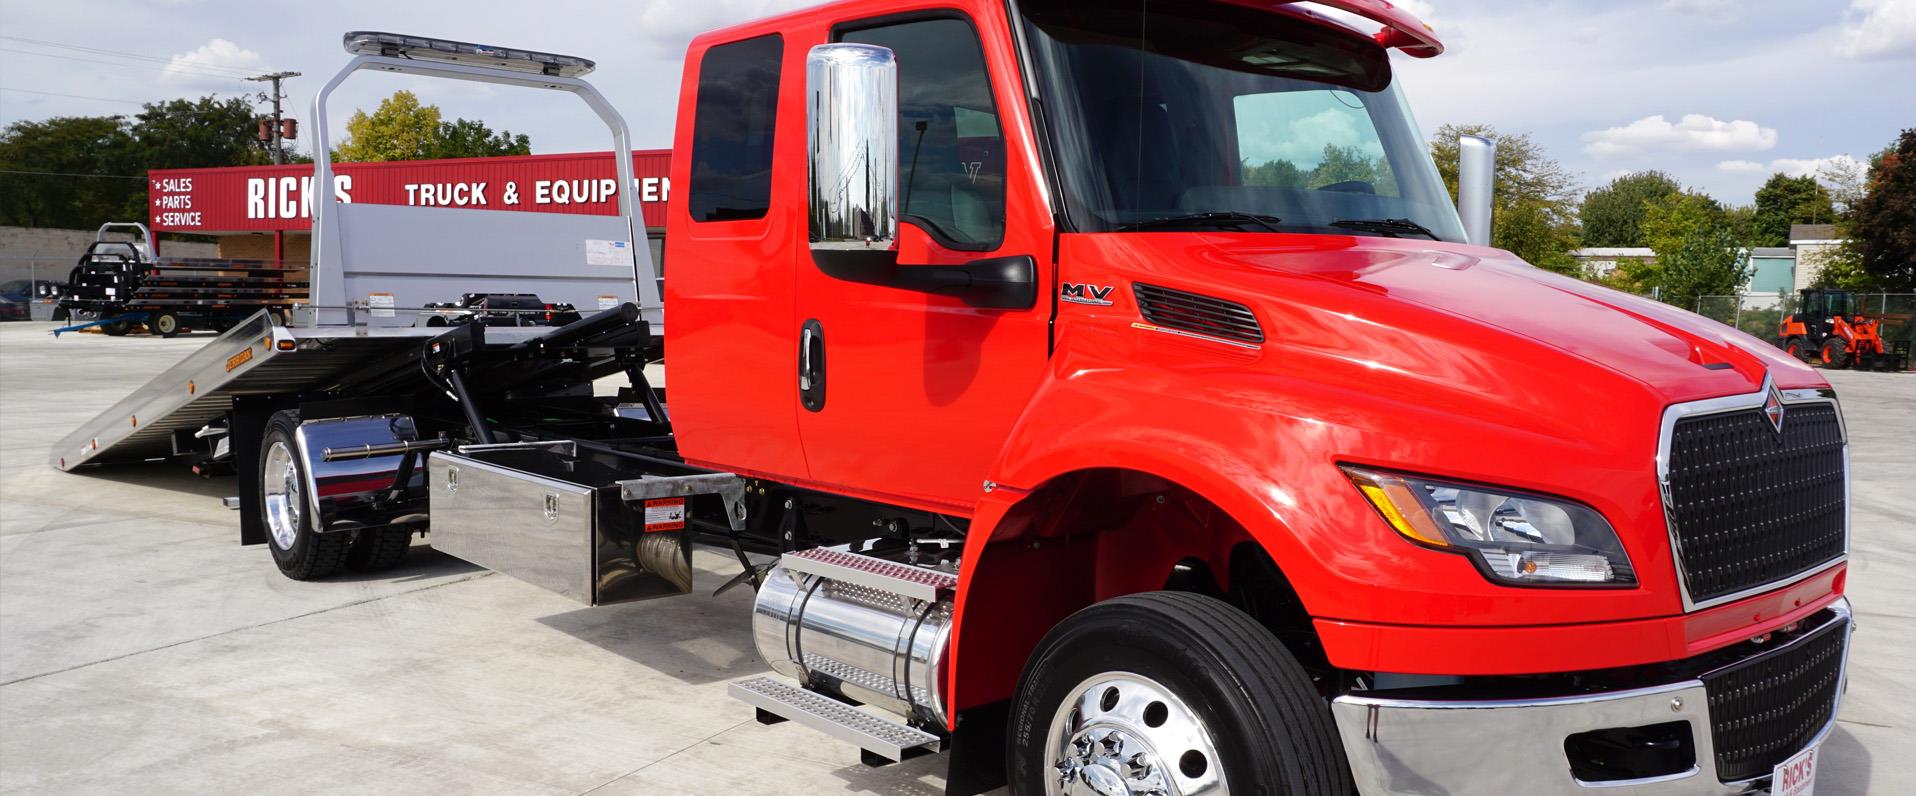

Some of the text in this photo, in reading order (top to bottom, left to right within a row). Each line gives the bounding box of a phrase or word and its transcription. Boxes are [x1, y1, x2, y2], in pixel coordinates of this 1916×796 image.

[162, 178, 192, 192] SALES
[405, 182, 487, 206] TRUCK
[503, 181, 519, 205] &
[162, 195, 191, 209] PARTS
[162, 212, 202, 226] SERVICE
[1061, 282, 1114, 300] MV
